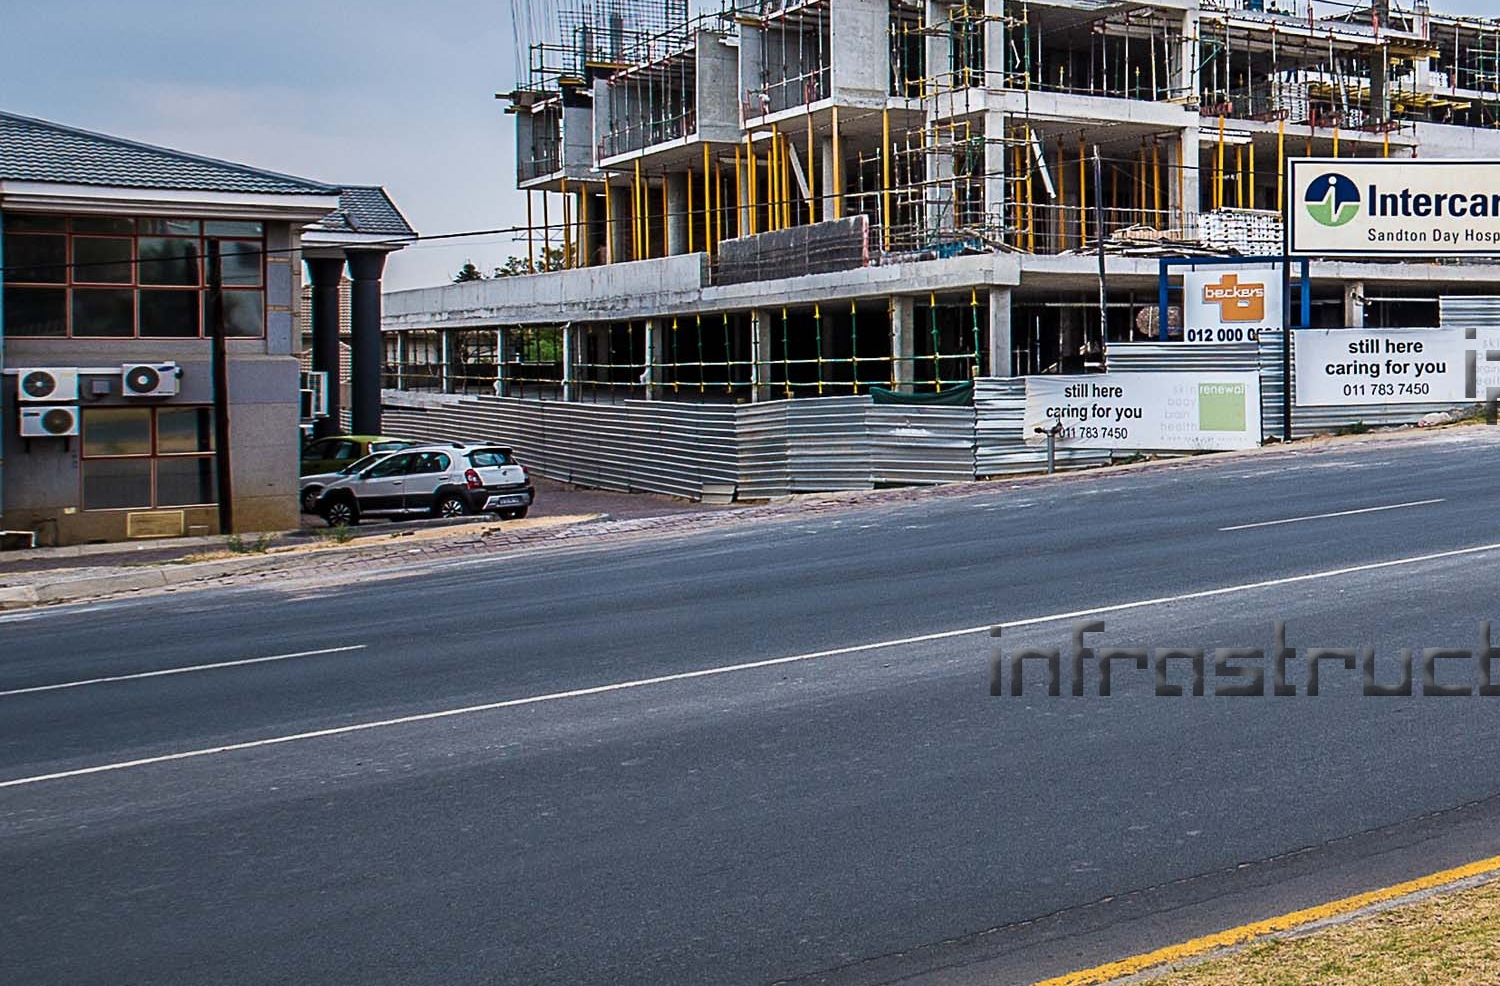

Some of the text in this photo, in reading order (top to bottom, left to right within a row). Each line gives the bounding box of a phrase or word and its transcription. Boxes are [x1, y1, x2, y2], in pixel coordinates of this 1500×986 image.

[1368, 228, 1427, 242] Sandton
[1433, 228, 1460, 244] Day
[1204, 286, 1265, 299] beckers
[1187, 329, 1213, 343] 012
[1217, 328, 1244, 342] 000
[1348, 338, 1424, 355] still here
[1325, 360, 1447, 380] caring for you
[1064, 383, 1123, 398] still here
[1199, 385, 1245, 395] renewal
[1343, 383, 1430, 396] 011 783 7450
[1046, 404, 1143, 422] caring for you
[1059, 427, 1129, 440] 011 783 7450
